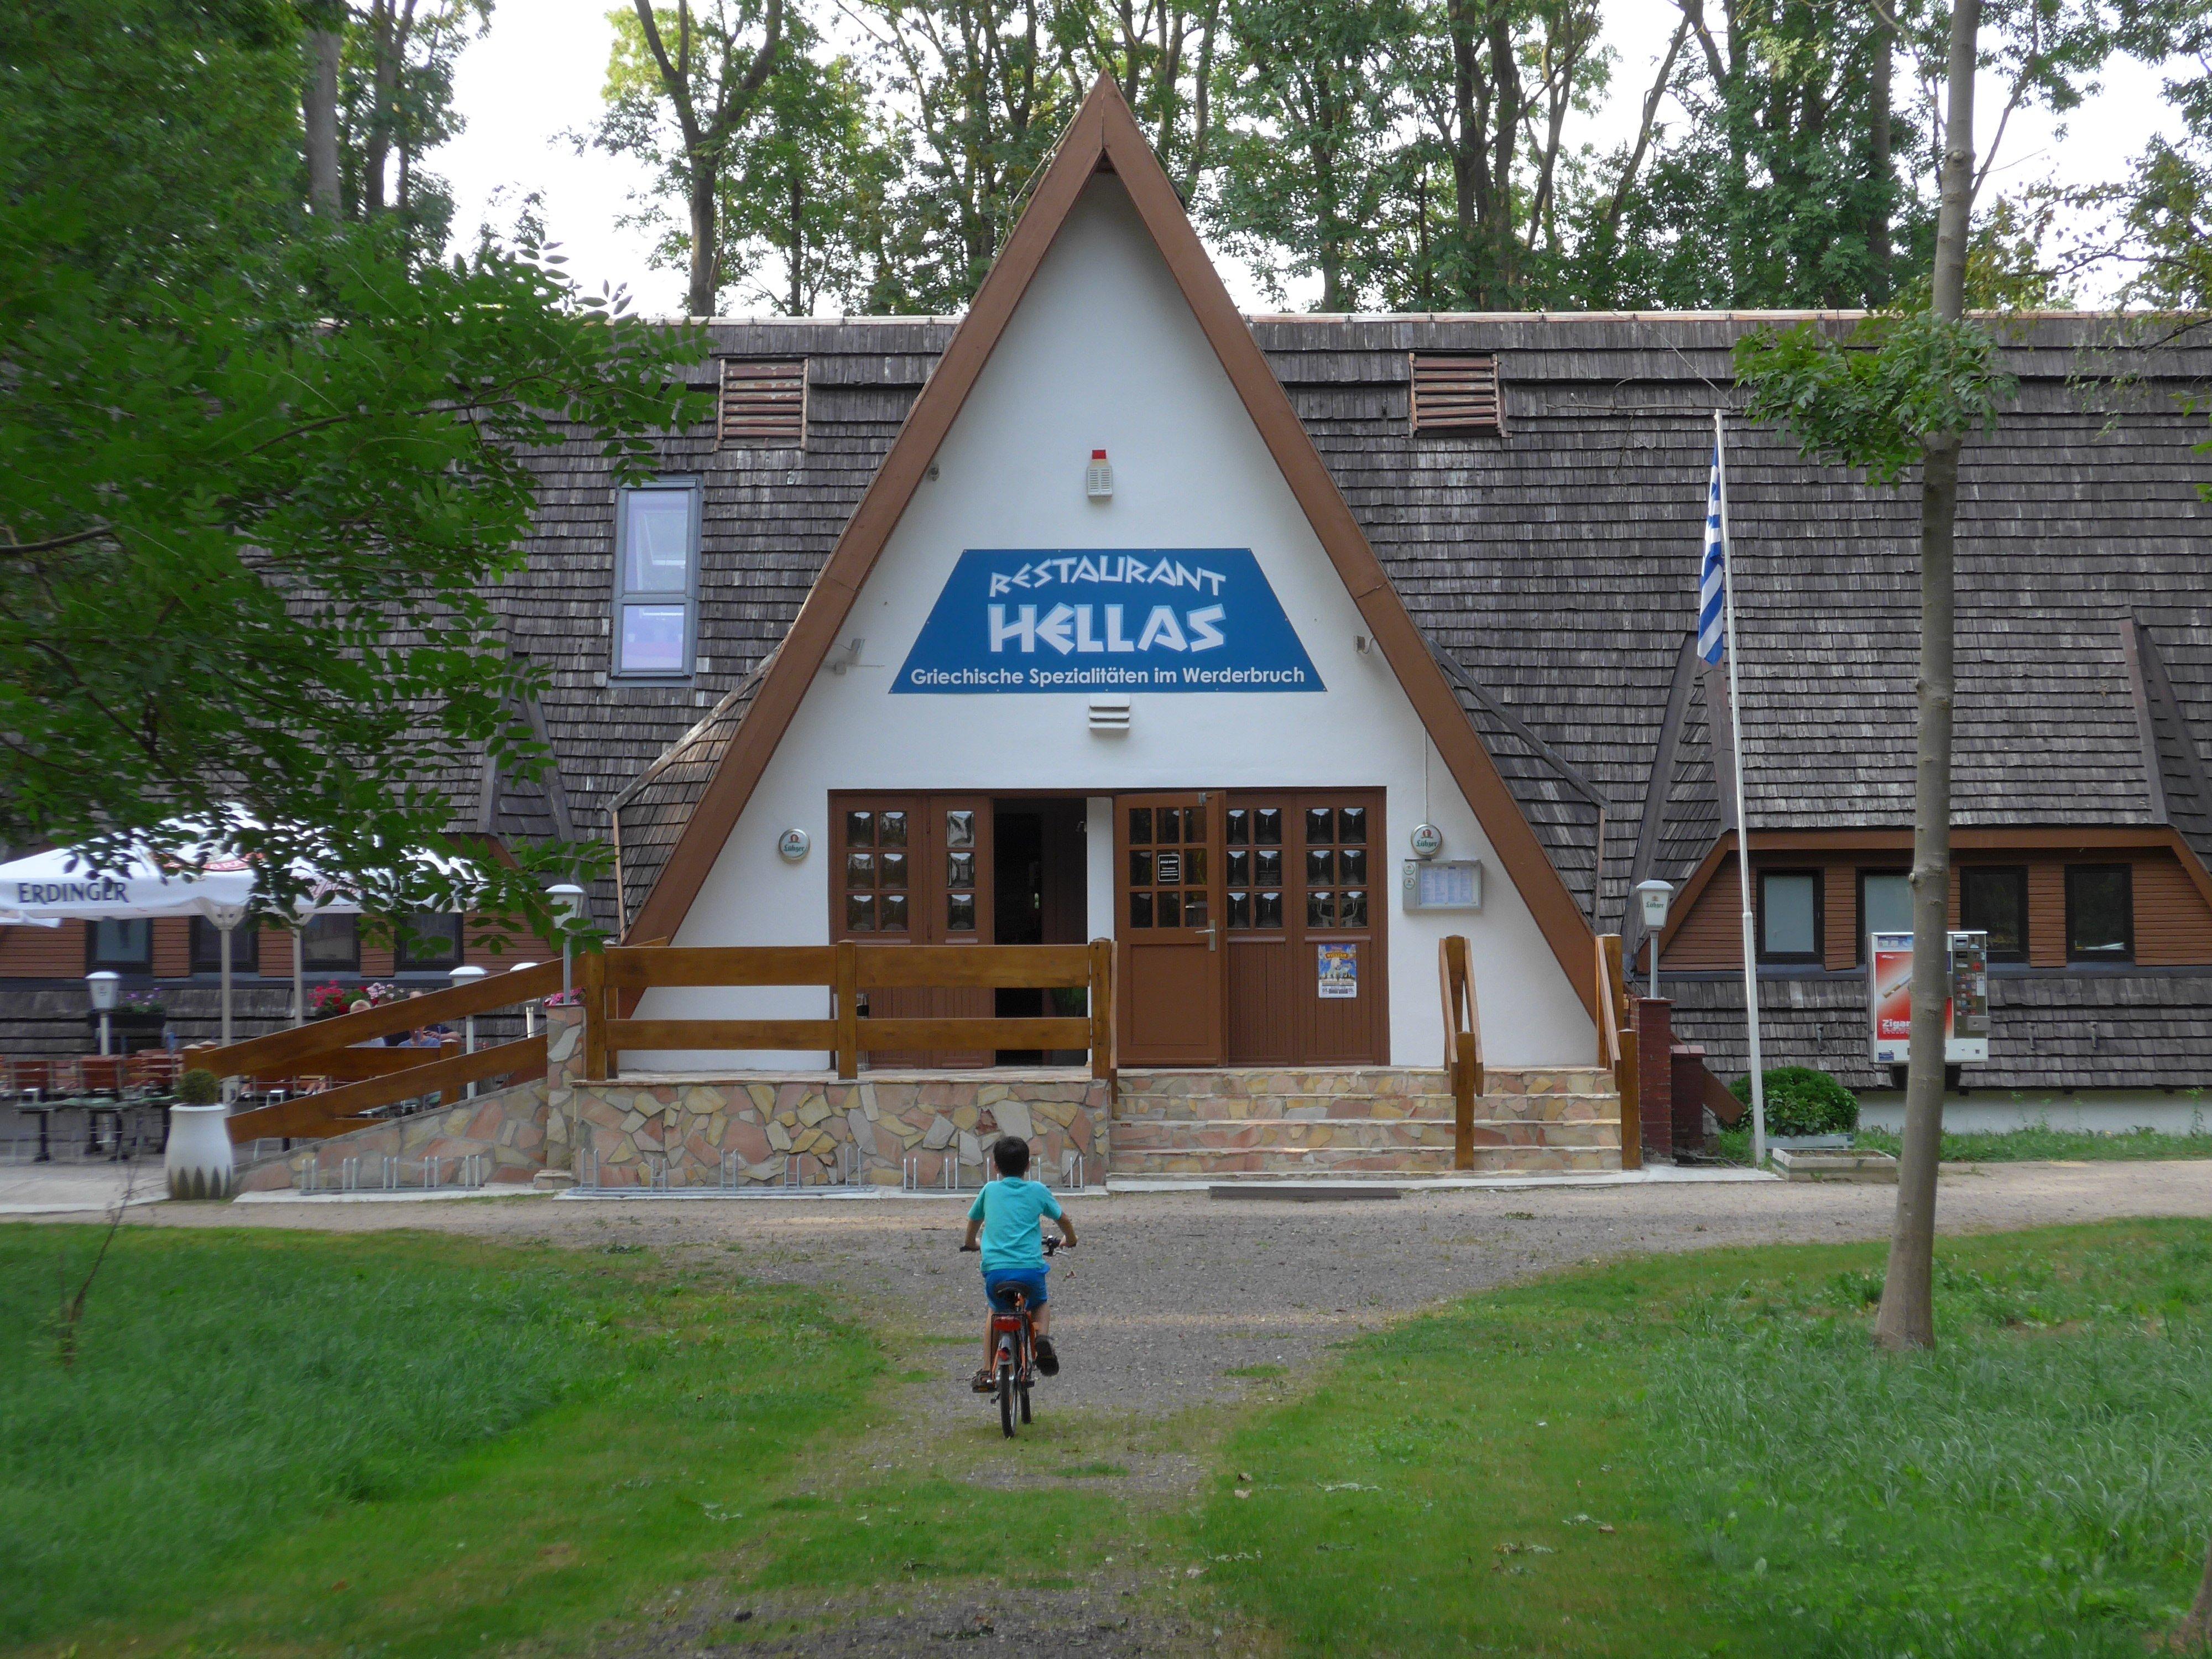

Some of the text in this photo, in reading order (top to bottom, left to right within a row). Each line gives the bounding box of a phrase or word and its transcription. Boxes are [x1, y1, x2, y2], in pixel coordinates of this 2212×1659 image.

[989, 555, 1226, 597] RESTAURANT
[988, 603, 1226, 655] HELLAS
[911, 666, 1305, 687] Griechische Spezialitäten im Werderbruch
[17, 883, 129, 905] ERDINGER
[1882, 1019, 1911, 1029] Zigar
